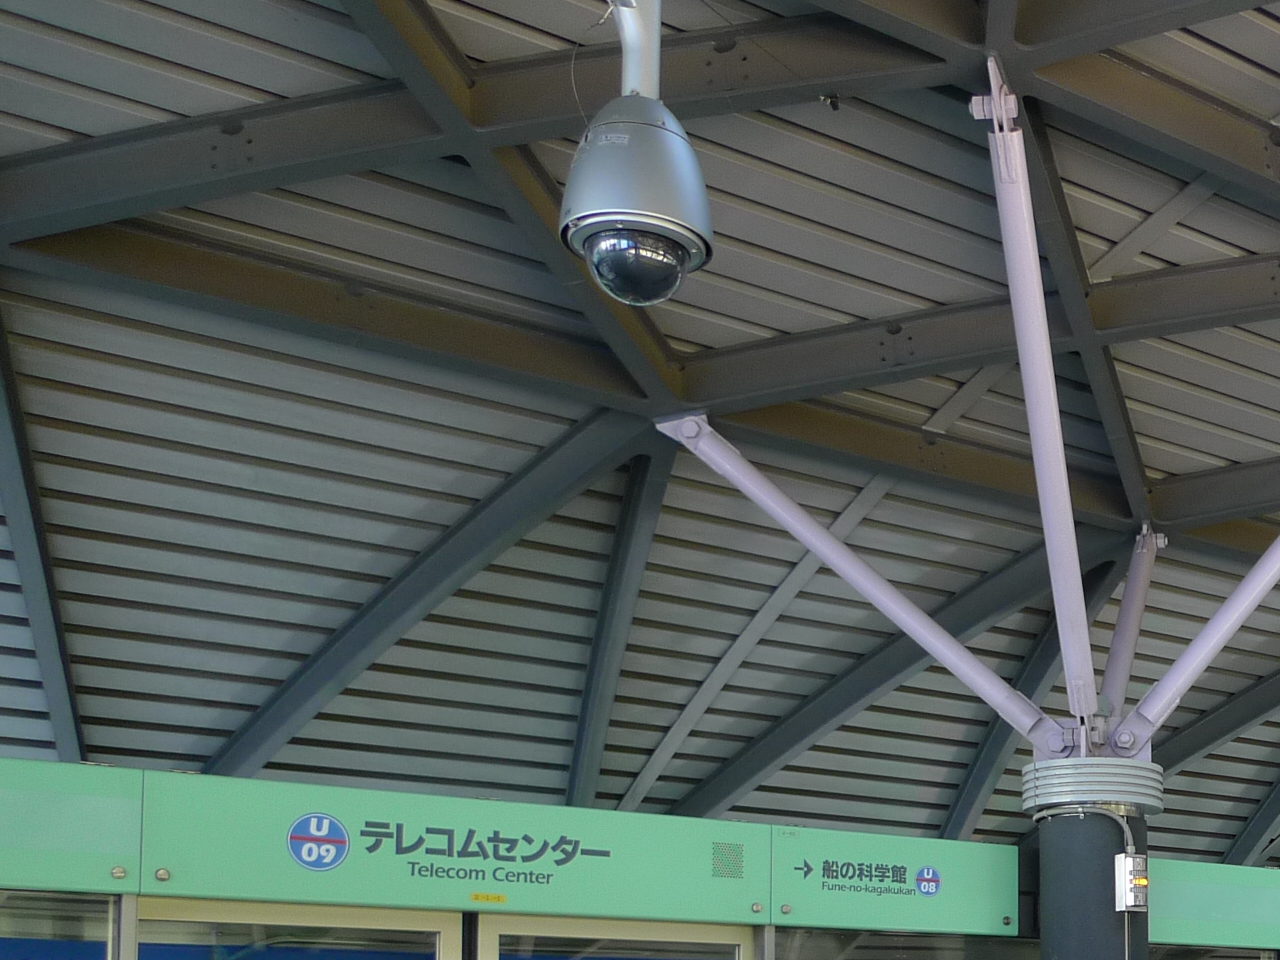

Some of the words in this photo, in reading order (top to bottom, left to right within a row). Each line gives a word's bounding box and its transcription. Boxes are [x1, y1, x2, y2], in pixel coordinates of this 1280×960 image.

[309, 818, 329, 836] U
[301, 842, 337, 863] 09
[360, 820, 611, 866] テレコムセンター
[407, 862, 486, 881] Telecom
[492, 866, 554, 885] Center
[822, 860, 907, 884] 船の科学館
[924, 868, 933, 879] U
[821, 881, 916, 897] Fune-no-kagakukan
[921, 882, 936, 894] 08
